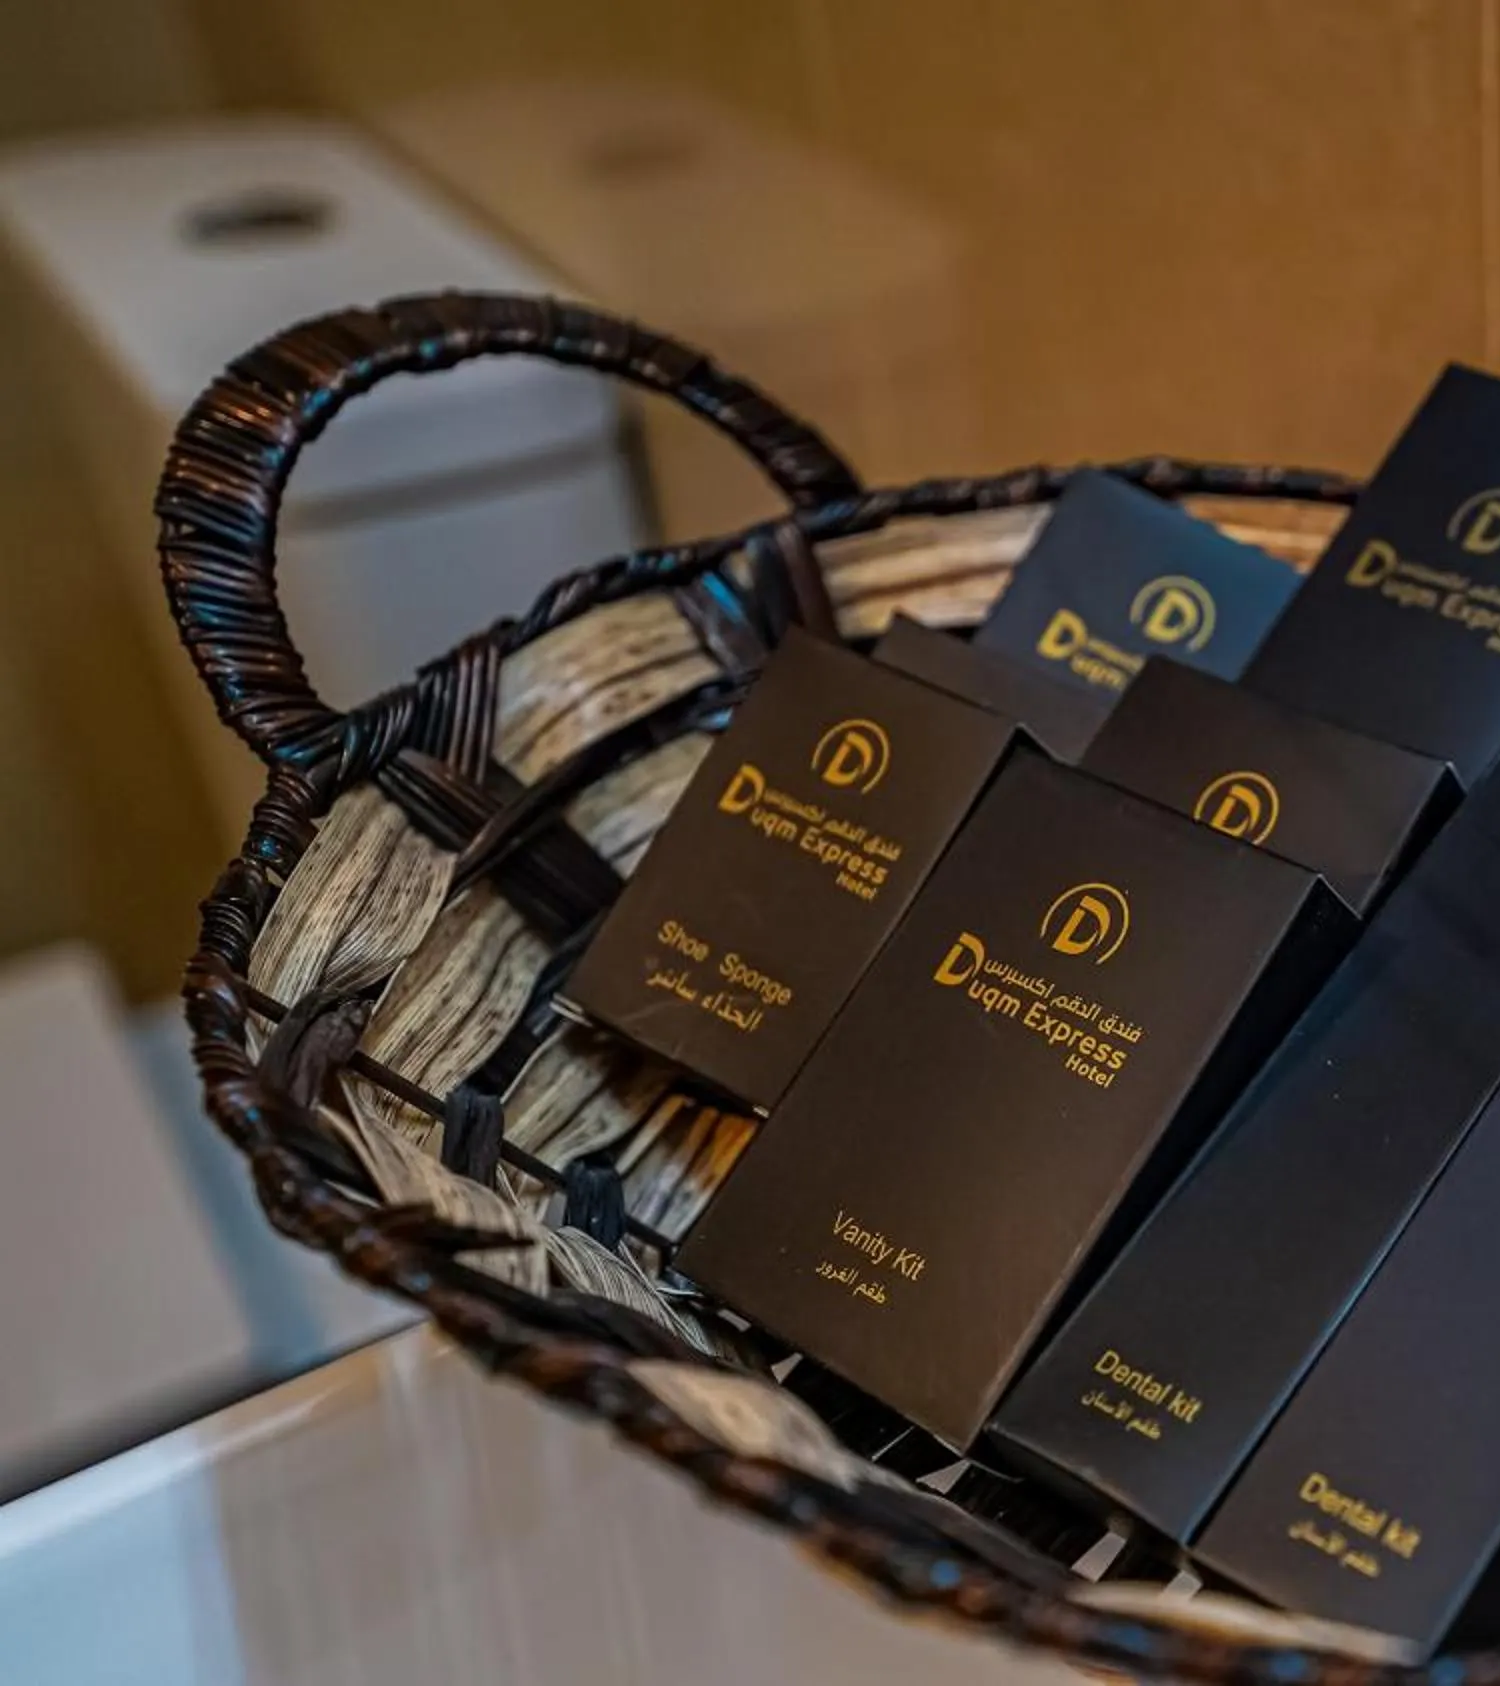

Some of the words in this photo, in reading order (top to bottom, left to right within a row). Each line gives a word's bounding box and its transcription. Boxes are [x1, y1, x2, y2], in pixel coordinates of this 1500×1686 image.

[718, 763, 797, 841] Duqm
[800, 826, 888, 885] Express
[657, 919, 710, 962] Shoe
[719, 952, 793, 1005] Sponge
[933, 931, 1021, 1018] Duqm
[1023, 1001, 1127, 1070] Express
[1051, 994, 1101, 1022] الدقم
[1098, 1013, 1143, 1043] فندق
[1065, 1053, 1115, 1089] Hotel
[833, 1210, 894, 1265] Vanity
[892, 1247, 927, 1281] Kit
[1094, 1350, 1173, 1405] Dental
[1167, 1390, 1203, 1424] kit
[1300, 1472, 1388, 1538] Dental
[1381, 1517, 1421, 1559] kit
